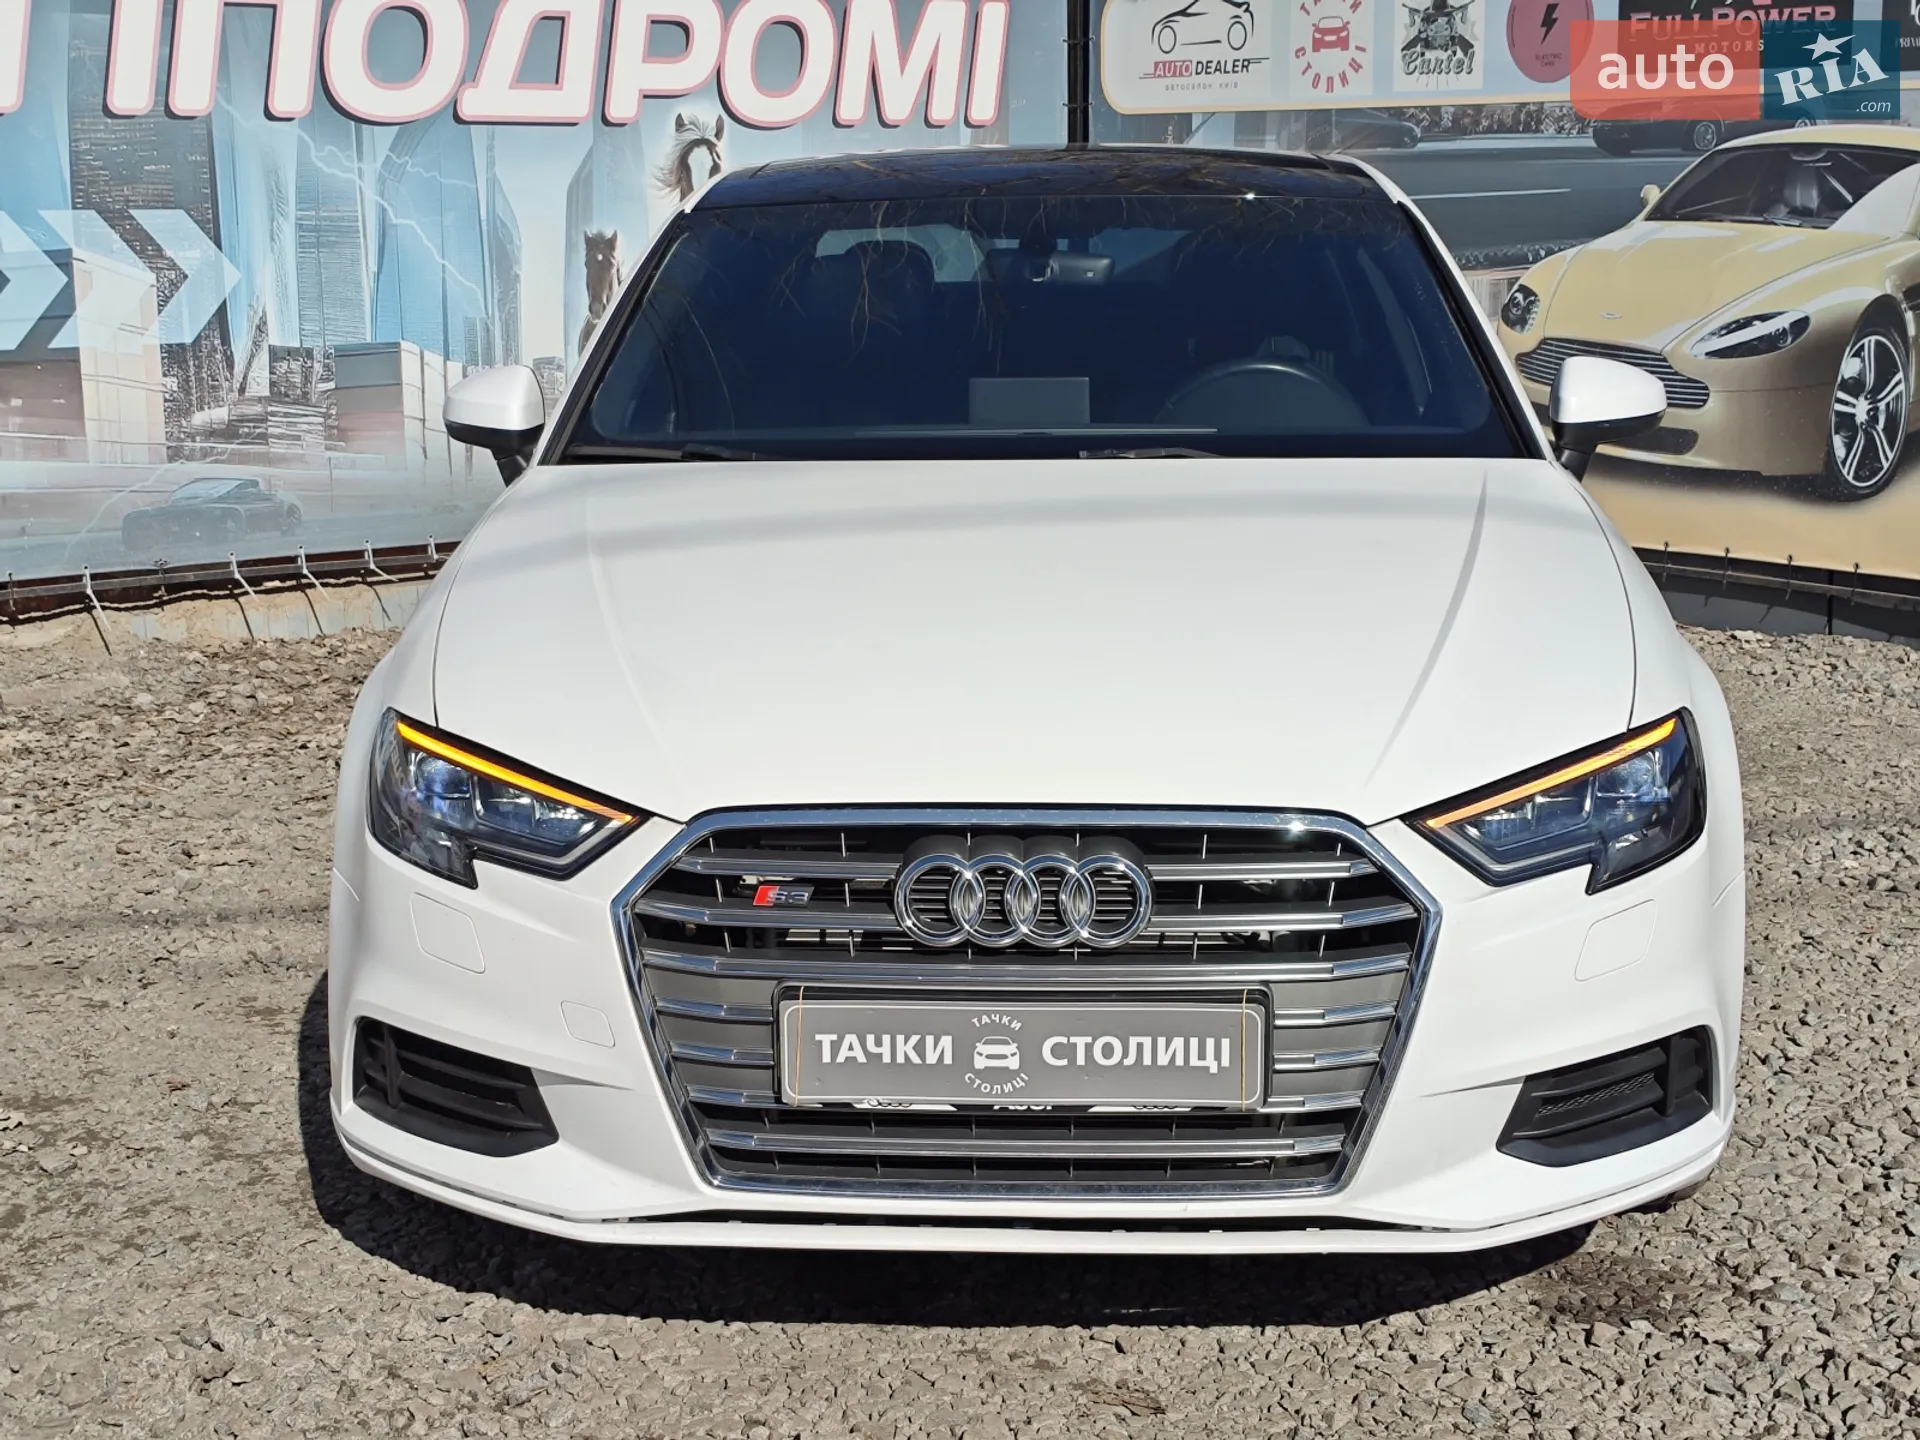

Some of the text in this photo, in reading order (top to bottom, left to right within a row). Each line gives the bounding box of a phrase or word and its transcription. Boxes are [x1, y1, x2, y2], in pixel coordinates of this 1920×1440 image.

[1695, 39, 1765, 54] MOTORS
[1155, 59, 1251, 77] AUTO DEALER
[768, 890, 810, 905] S3
[971, 1013, 1022, 1031] ТАЧКИ
[815, 1033, 1231, 1074] ТАЧКИ СТОЛИЦІ
[964, 1072, 1029, 1095] СТОЛИЦІ
